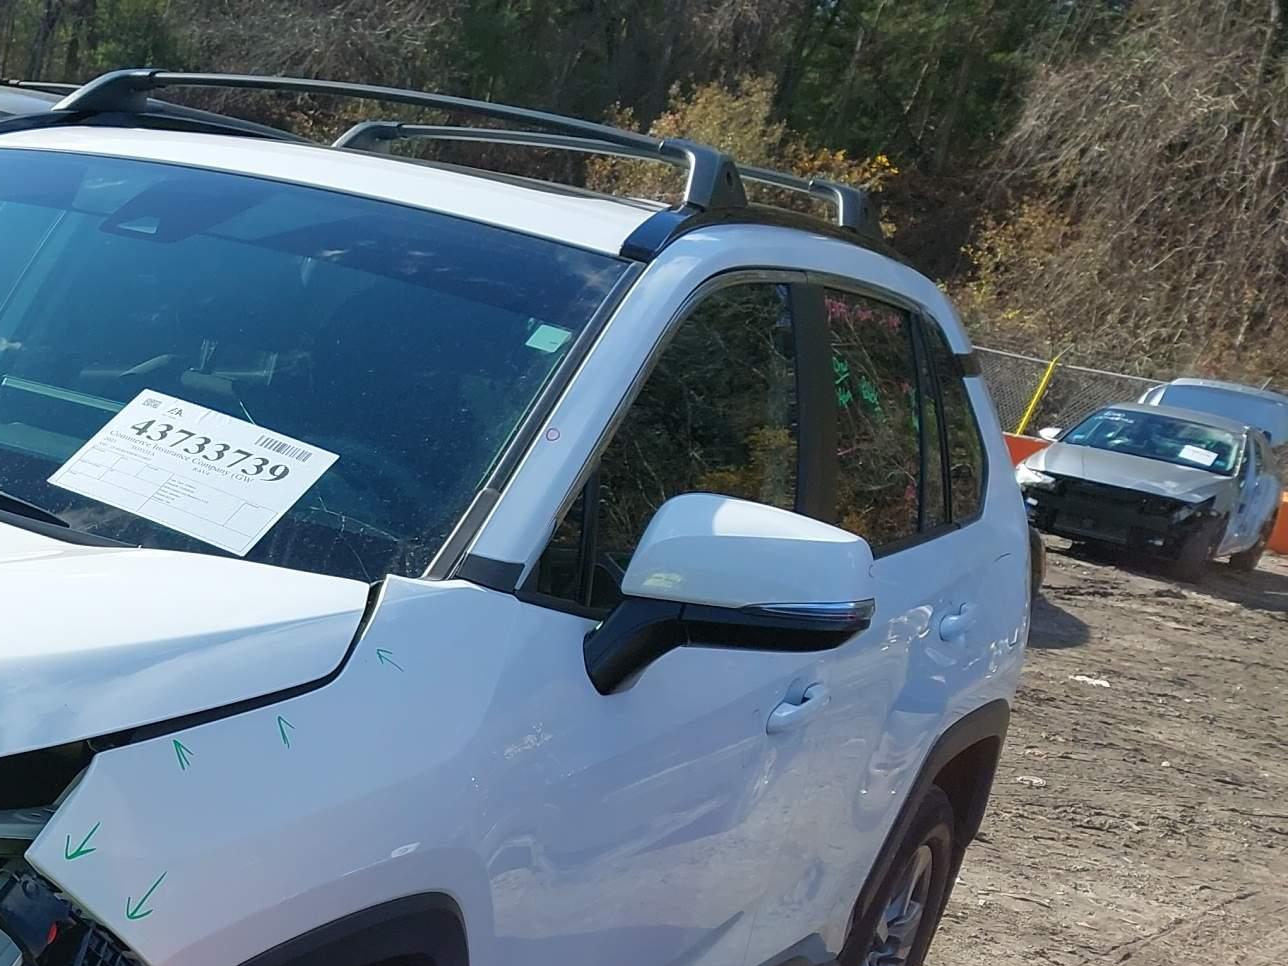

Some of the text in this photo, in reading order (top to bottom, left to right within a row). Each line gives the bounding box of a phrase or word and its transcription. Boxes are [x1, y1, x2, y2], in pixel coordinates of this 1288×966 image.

[109, 430, 152, 447] Commerce
[152, 443, 192, 461] Insurance
[192, 457, 231, 476] Company
[130, 419, 290, 482] 43733739
